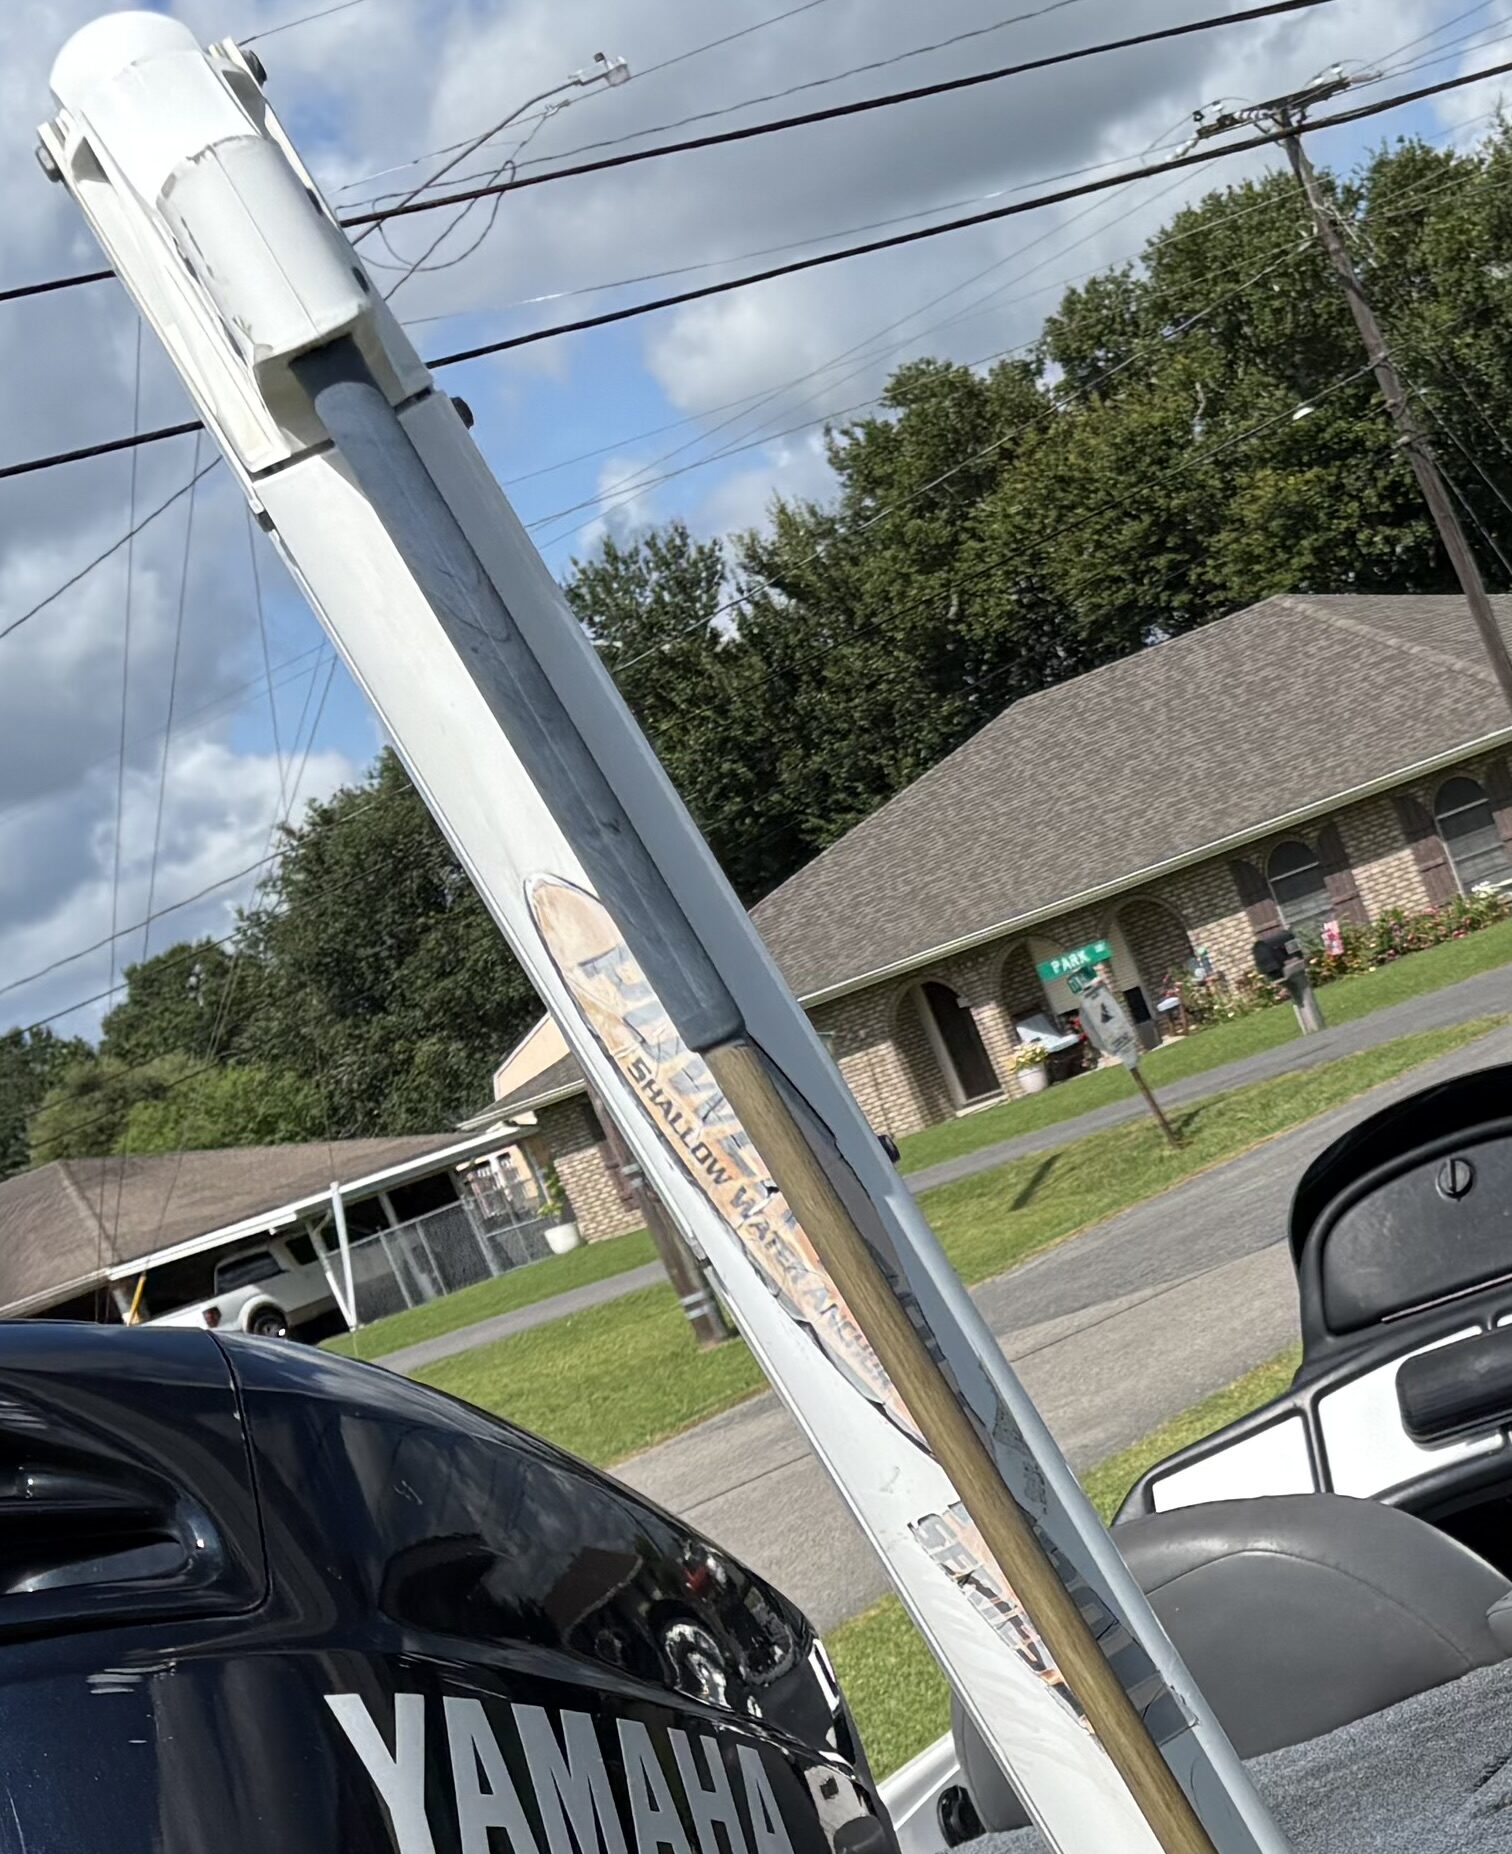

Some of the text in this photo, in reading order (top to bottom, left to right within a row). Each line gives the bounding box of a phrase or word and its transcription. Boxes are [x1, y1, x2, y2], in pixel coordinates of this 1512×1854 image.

[1050, 950, 1091, 974] PARK
[627, 1057, 732, 1186] SHALLOW
[730, 1186, 813, 1287] WATER
